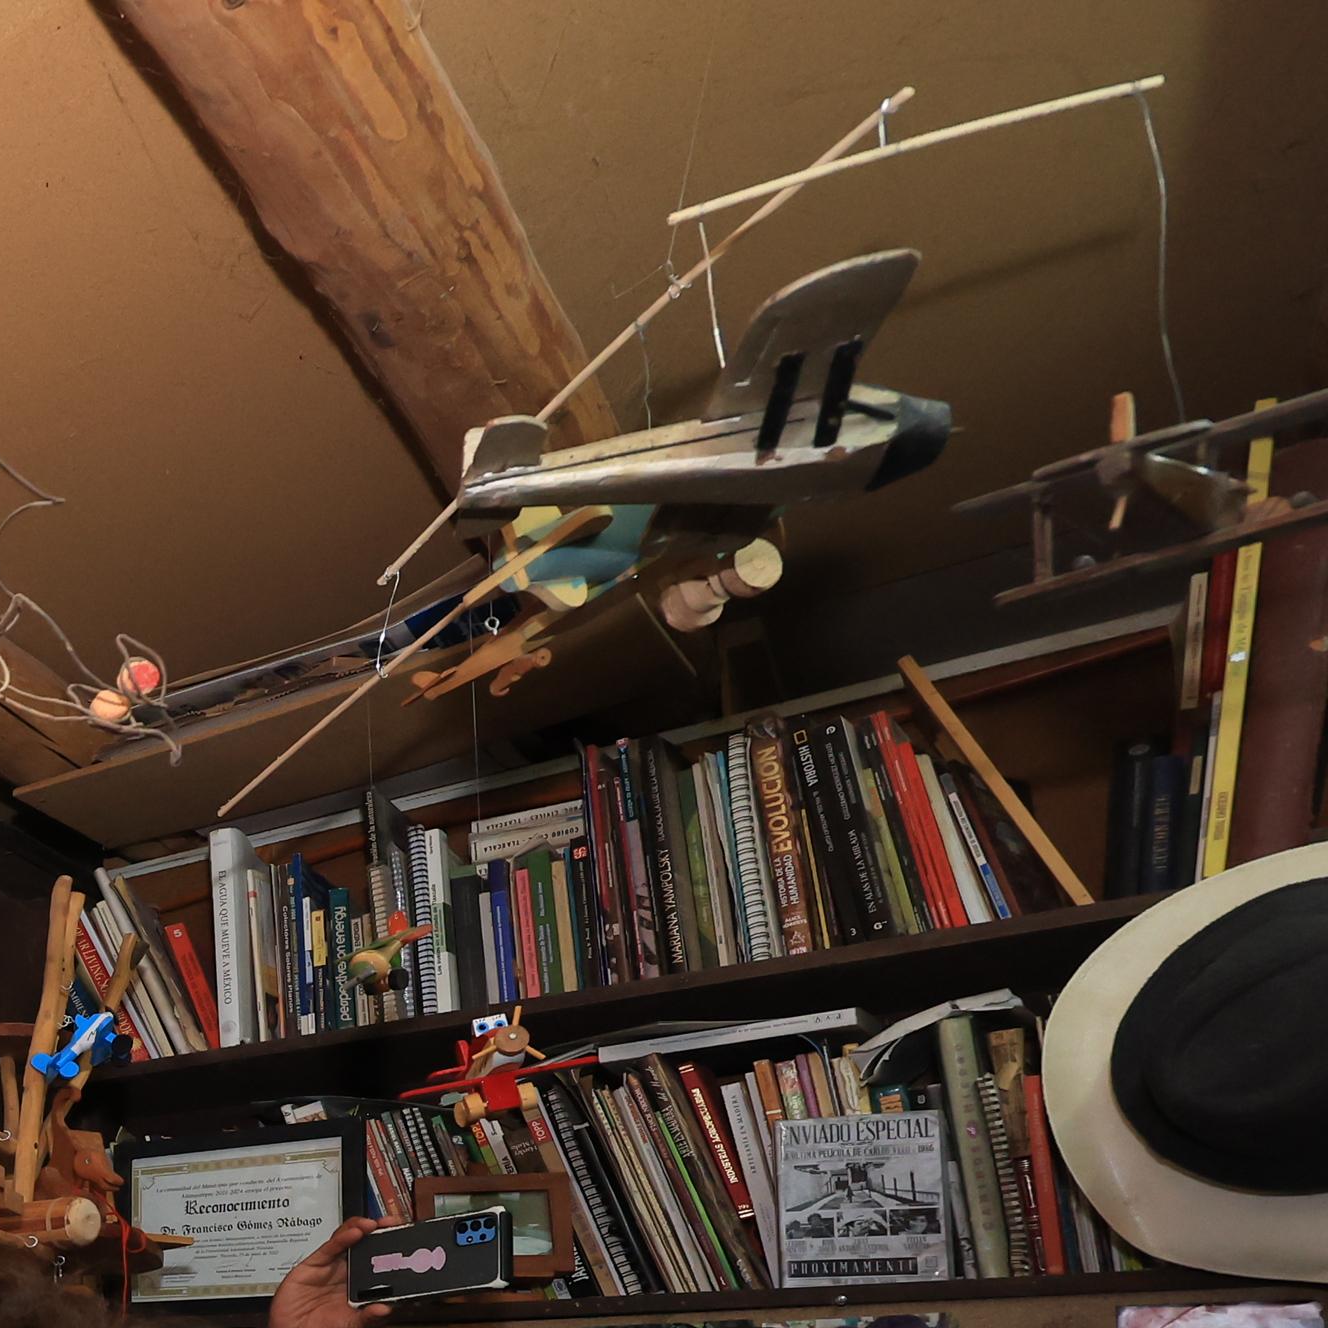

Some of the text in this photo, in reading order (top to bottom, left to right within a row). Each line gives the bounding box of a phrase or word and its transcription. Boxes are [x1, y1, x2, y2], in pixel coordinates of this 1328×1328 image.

[798, 745, 819, 787] HISTORIA
[484, 841, 520, 853] TLAXCALA
[218, 870, 226, 881] EL
[783, 854, 800, 905] HUMANIDAD
[218, 882, 228, 907] AGUA
[659, 849, 683, 964] MARIANA YAMPOLSKY
[777, 879, 788, 908] HISTORIA
[219, 908, 229, 926] QUE
[334, 905, 346, 942] energy
[221, 929, 232, 959] MUEVE
[82, 944, 106, 982] LIVING
[222, 969, 233, 1005] MÉXICO
[532, 1121, 546, 1141] TOPP
[691, 1088, 740, 1184] INDUSTRIAS AGROPECUARIAS
[784, 1117, 934, 1147] ENVIADO ESPECIAL
[184, 1197, 290, 1215] Reconocimiento
[160, 1216, 322, 1236] Dr. Francisco Gómez Rábago
[790, 1259, 914, 1276] PROXIMAMENTE
